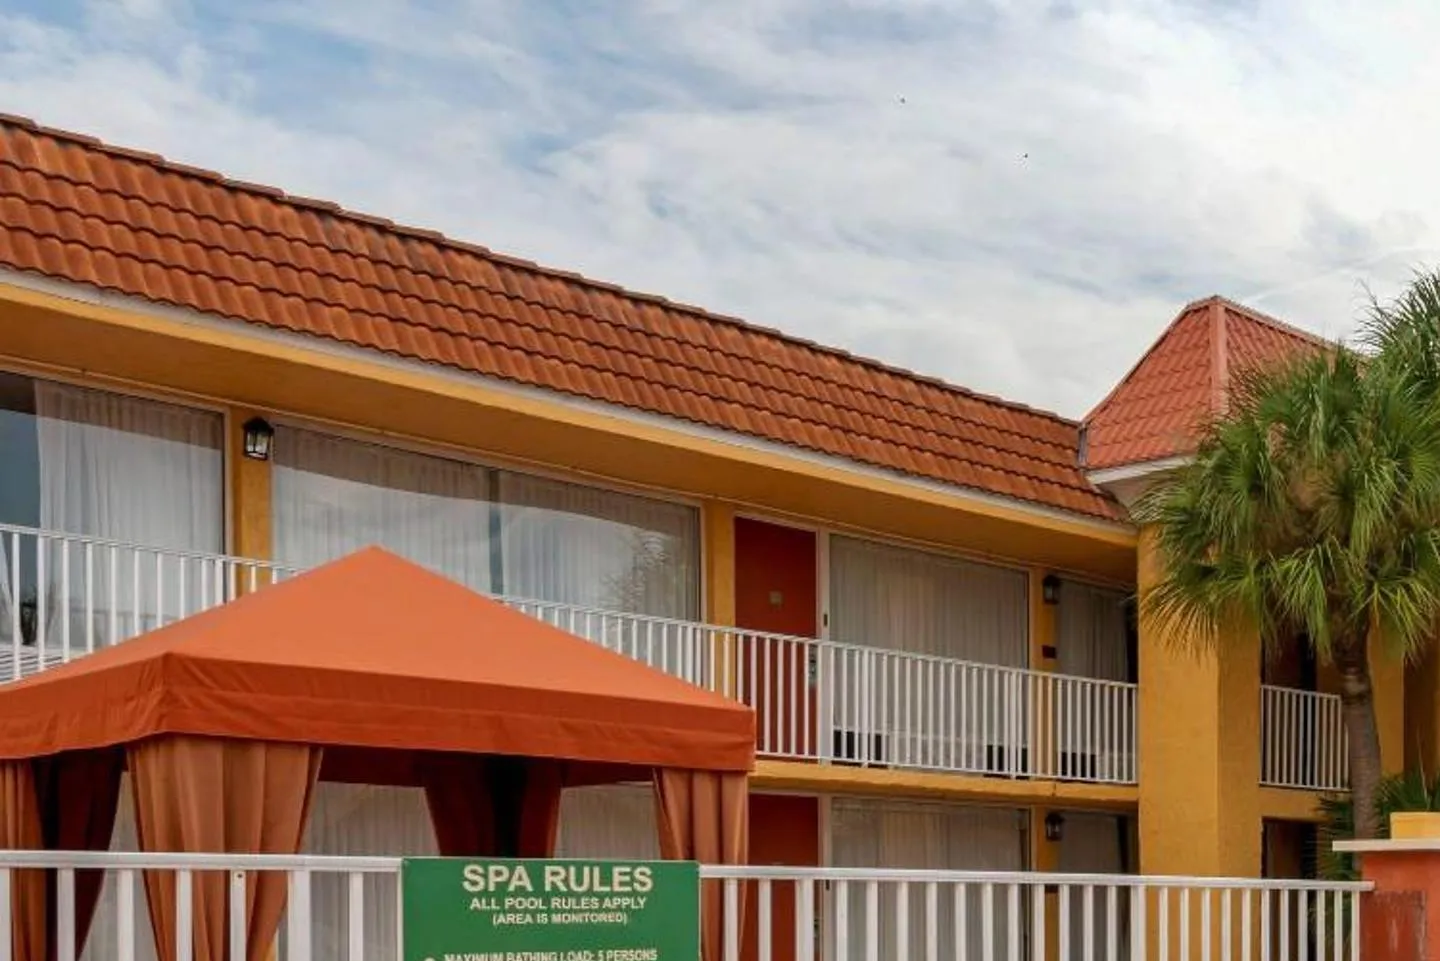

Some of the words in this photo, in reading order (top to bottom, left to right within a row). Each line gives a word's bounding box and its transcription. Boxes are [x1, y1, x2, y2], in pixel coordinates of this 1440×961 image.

[462, 864, 534, 892] SPA
[544, 866, 653, 892] RULES
[470, 898, 500, 910] ALL
[504, 897, 546, 910] POOL
[551, 897, 599, 909] RULES
[602, 897, 647, 909] APPLY
[492, 913, 532, 926] (AREA
[537, 913, 548, 924] IS
[551, 913, 628, 925] MONITORED)
